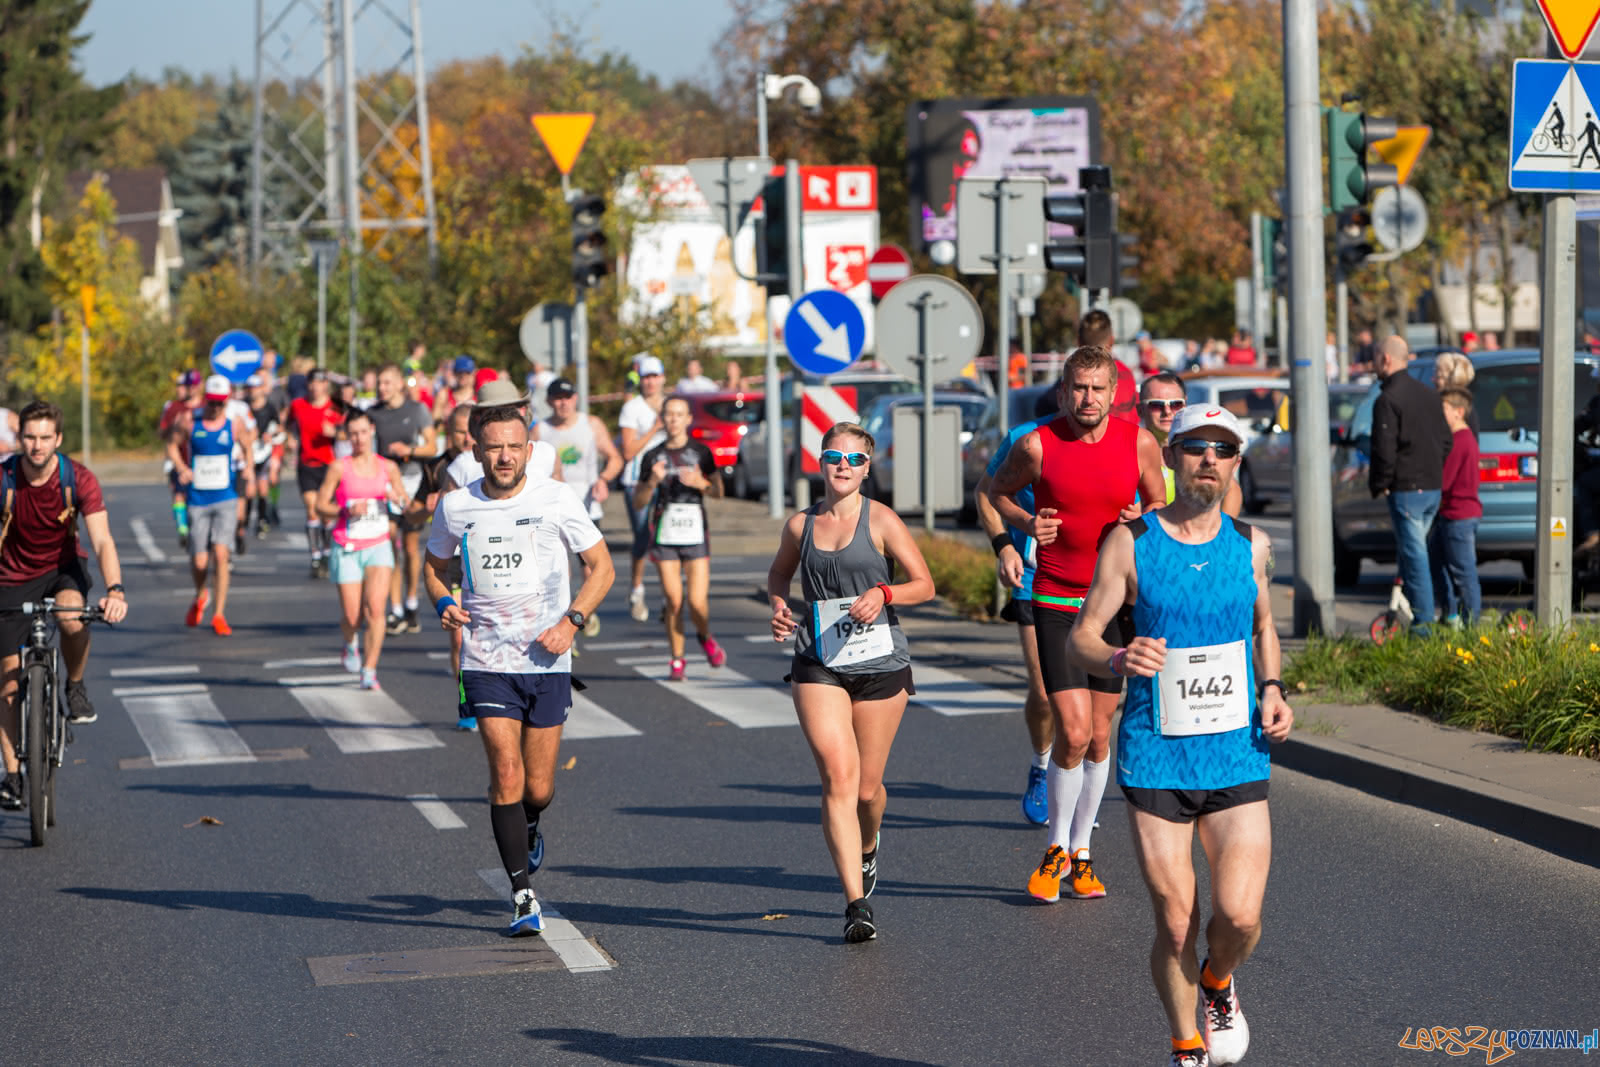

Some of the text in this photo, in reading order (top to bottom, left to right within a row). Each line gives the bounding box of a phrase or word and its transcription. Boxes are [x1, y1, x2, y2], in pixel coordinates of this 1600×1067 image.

[481, 553, 523, 570] 2219
[833, 620, 875, 639] 1932
[1176, 674, 1234, 700] 1442
[1188, 702, 1225, 711] Waldemar
